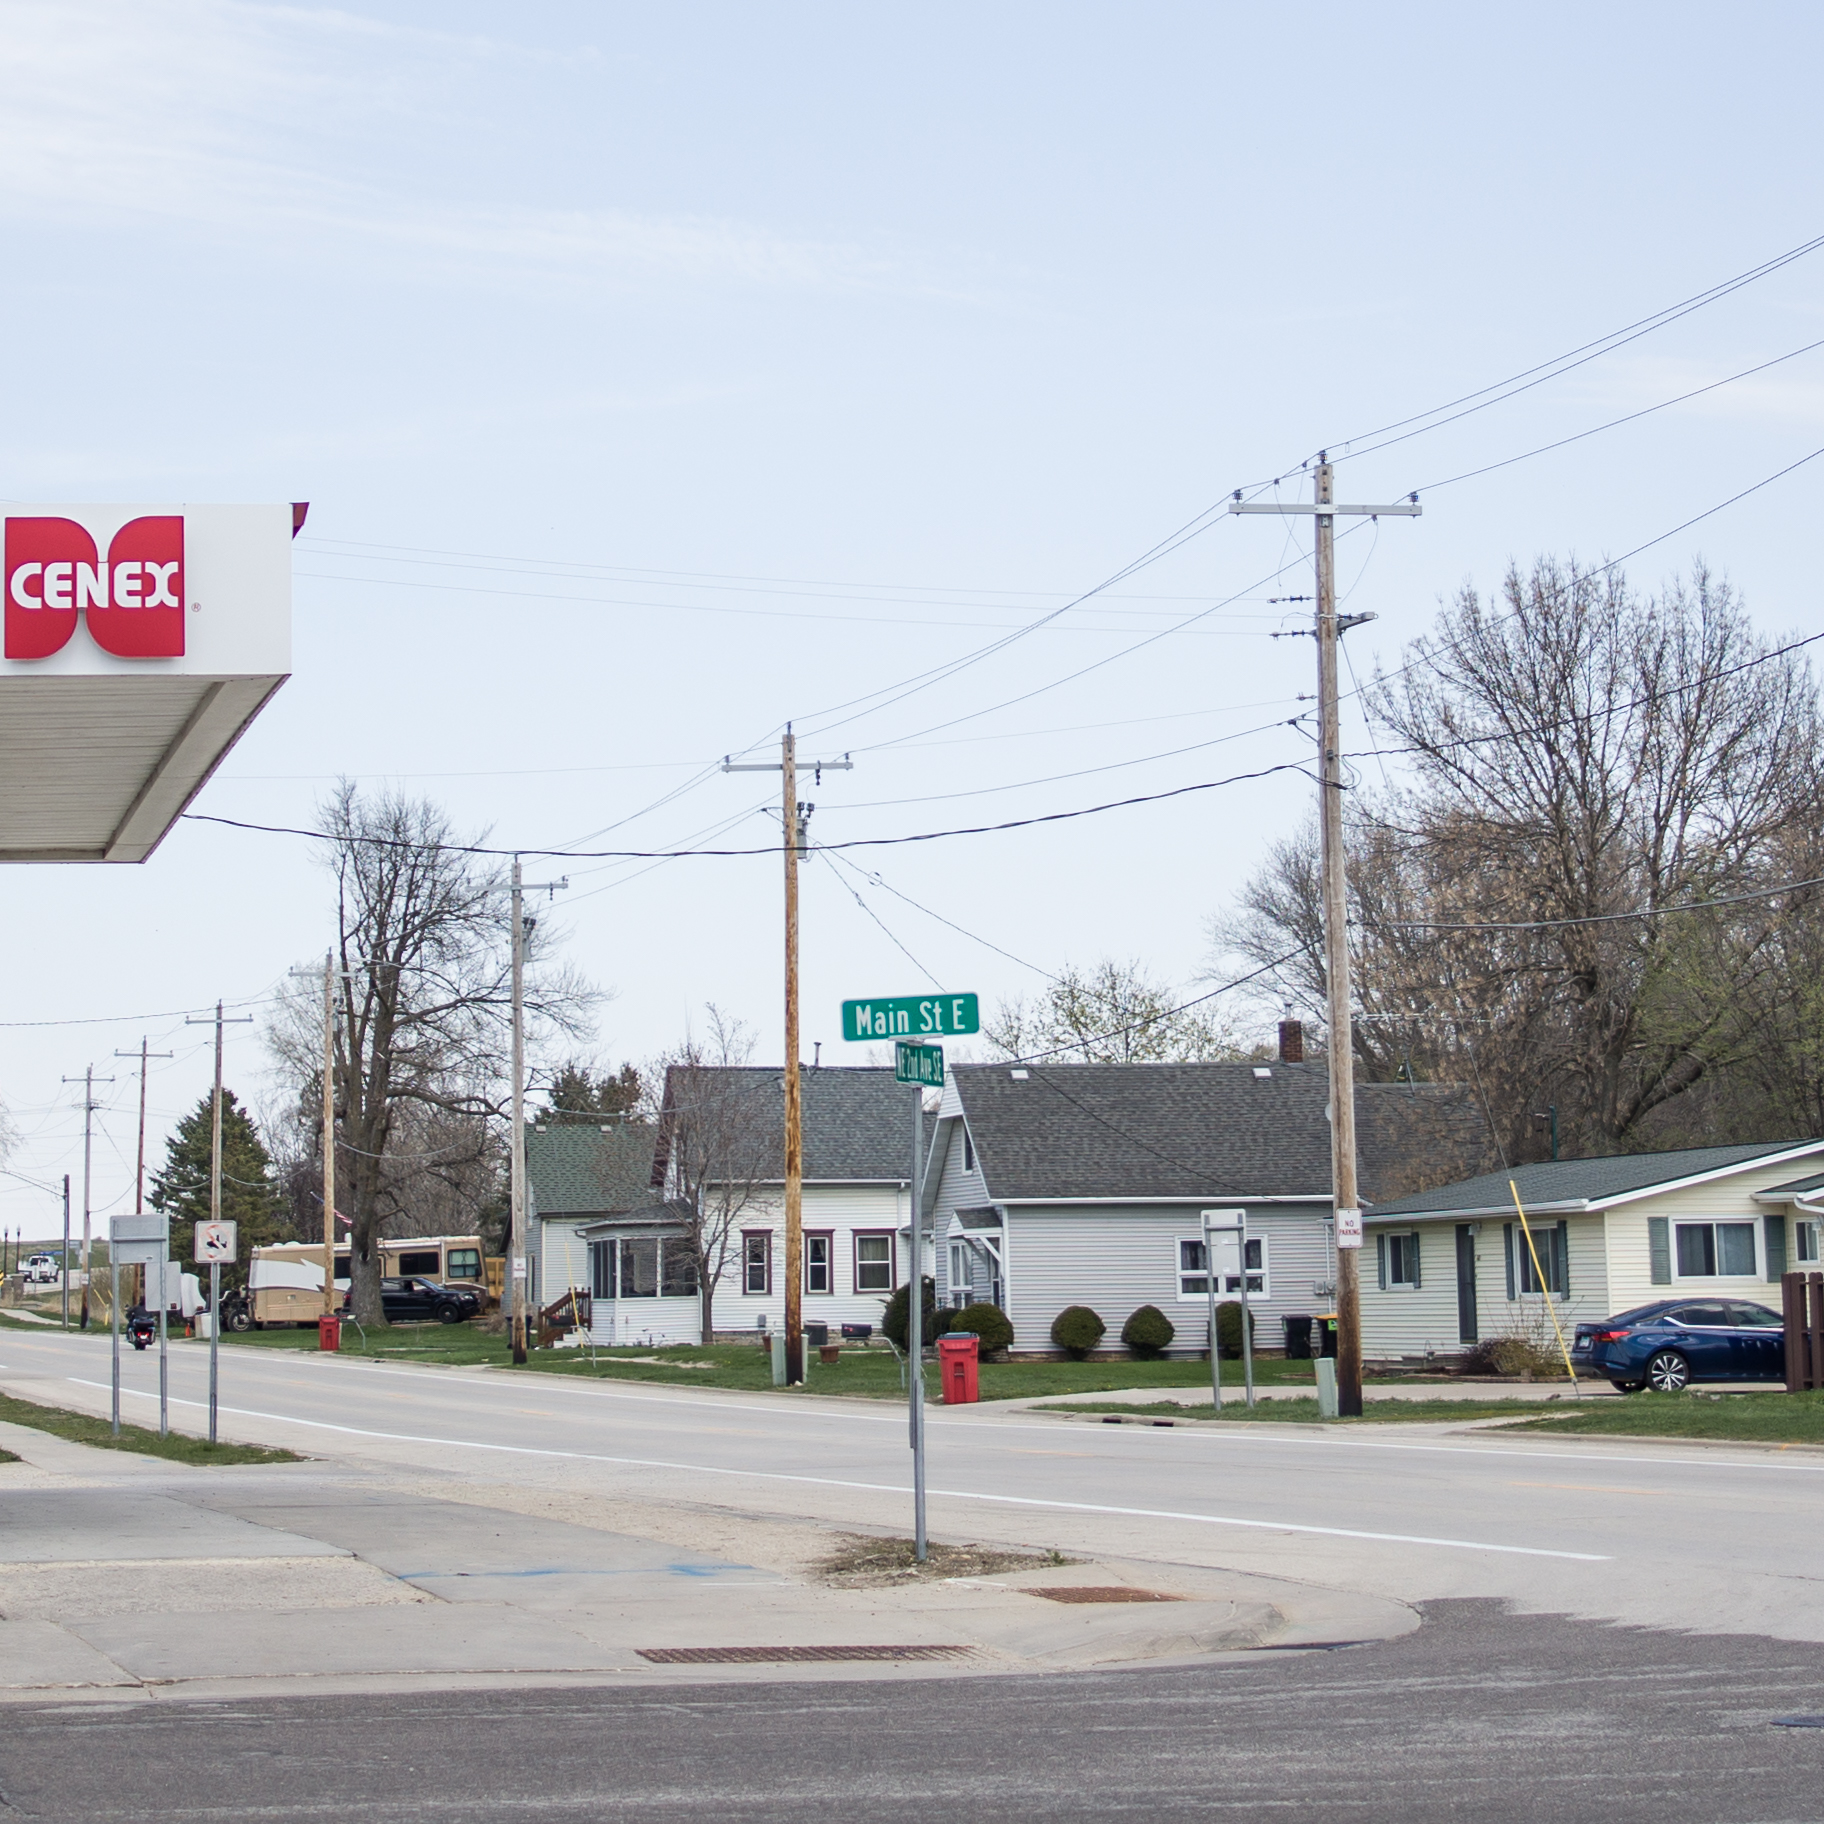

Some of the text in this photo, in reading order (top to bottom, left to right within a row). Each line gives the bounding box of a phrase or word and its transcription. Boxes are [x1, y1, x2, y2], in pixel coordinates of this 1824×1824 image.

[10, 560, 179, 609] CENEX
[856, 998, 966, 1036] Main St E
